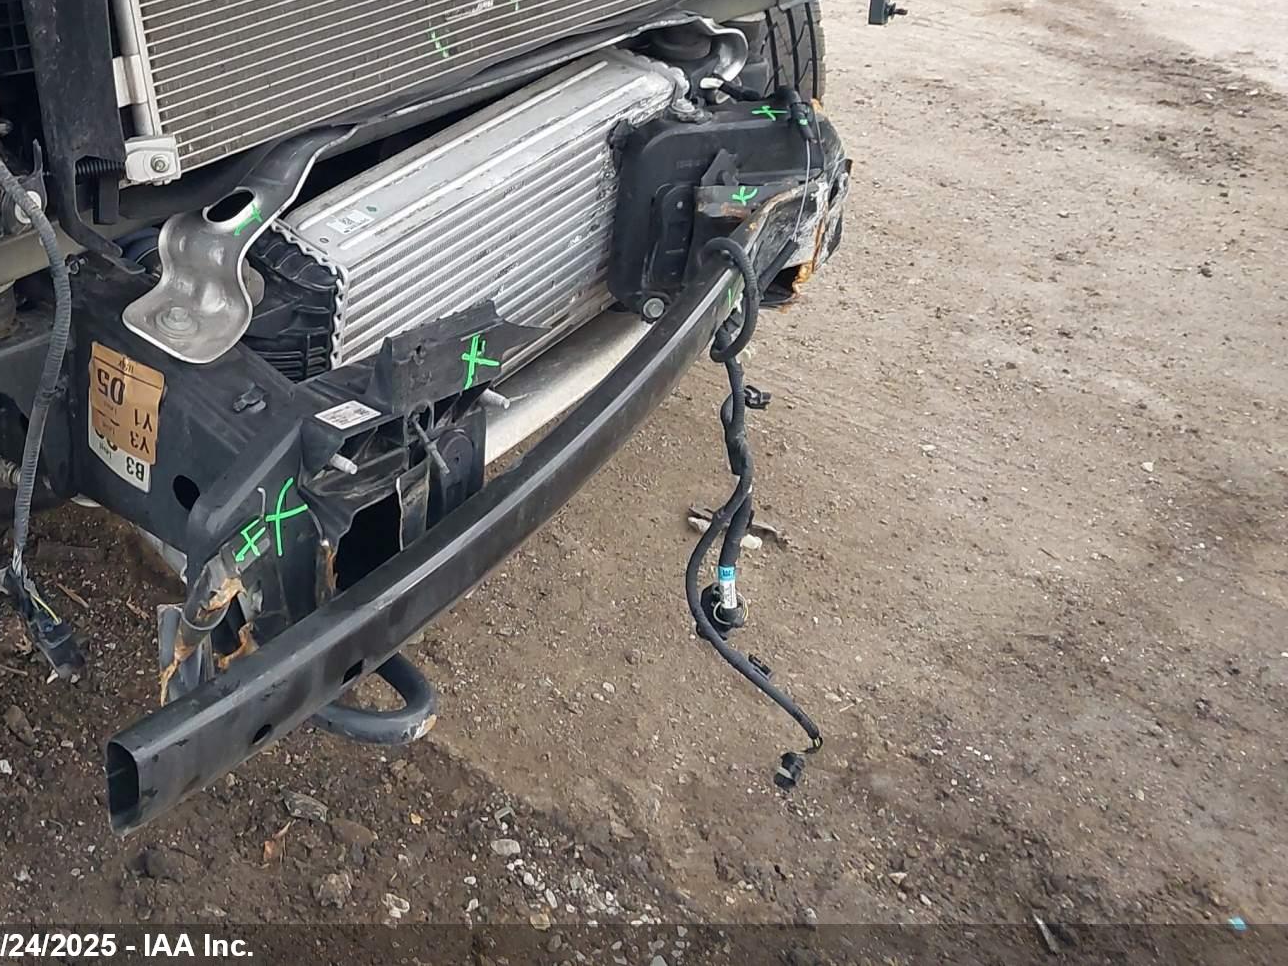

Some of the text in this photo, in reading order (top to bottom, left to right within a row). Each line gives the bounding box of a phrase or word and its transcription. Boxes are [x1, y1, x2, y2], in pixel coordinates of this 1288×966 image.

[134, 408, 153, 433] Y1
[130, 430, 150, 454] Y3
[126, 455, 145, 482] B3
